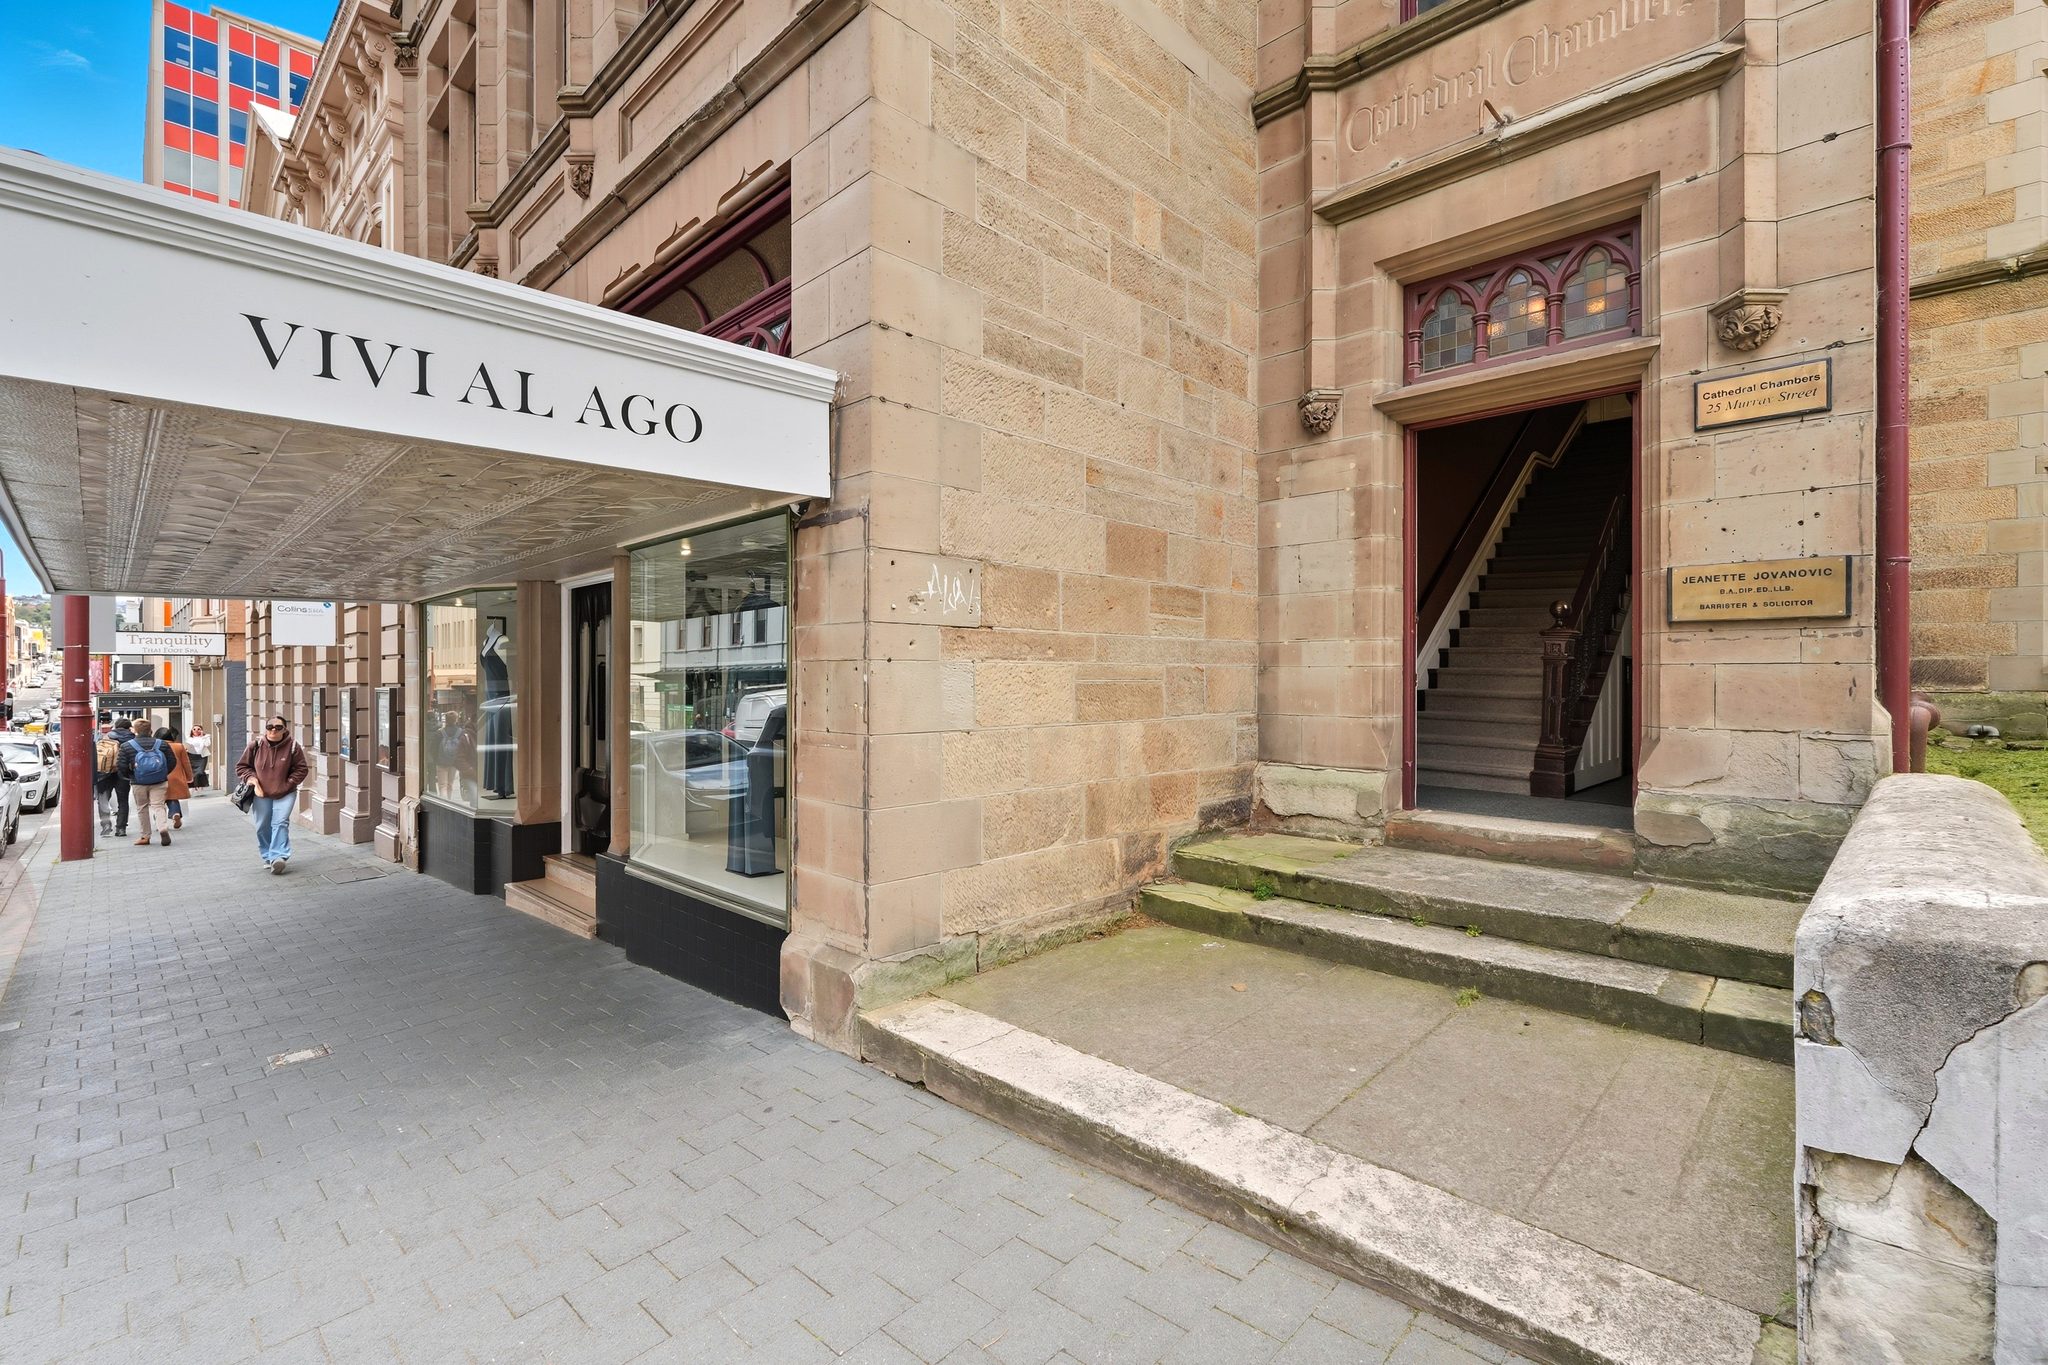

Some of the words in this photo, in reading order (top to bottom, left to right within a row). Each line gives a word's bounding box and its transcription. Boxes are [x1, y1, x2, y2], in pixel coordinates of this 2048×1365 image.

[1346, 49, 1496, 153] Cathedral
[240, 313, 436, 398] VIVI
[1702, 384, 1756, 400] Cathedral
[1760, 373, 1821, 390] Chambers
[1706, 402, 1721, 414] 25
[1725, 396, 1772, 411] Murray
[1778, 387, 1818, 402] Street
[1682, 573, 1746, 584] JEANETTE
[1753, 567, 1833, 580] JOVANOVIC
[277, 604, 307, 613] Collins
[1699, 602, 1748, 610] BARRISTER
[1763, 599, 1813, 608] SOLICITOR
[126, 634, 212, 648] Tranquility
